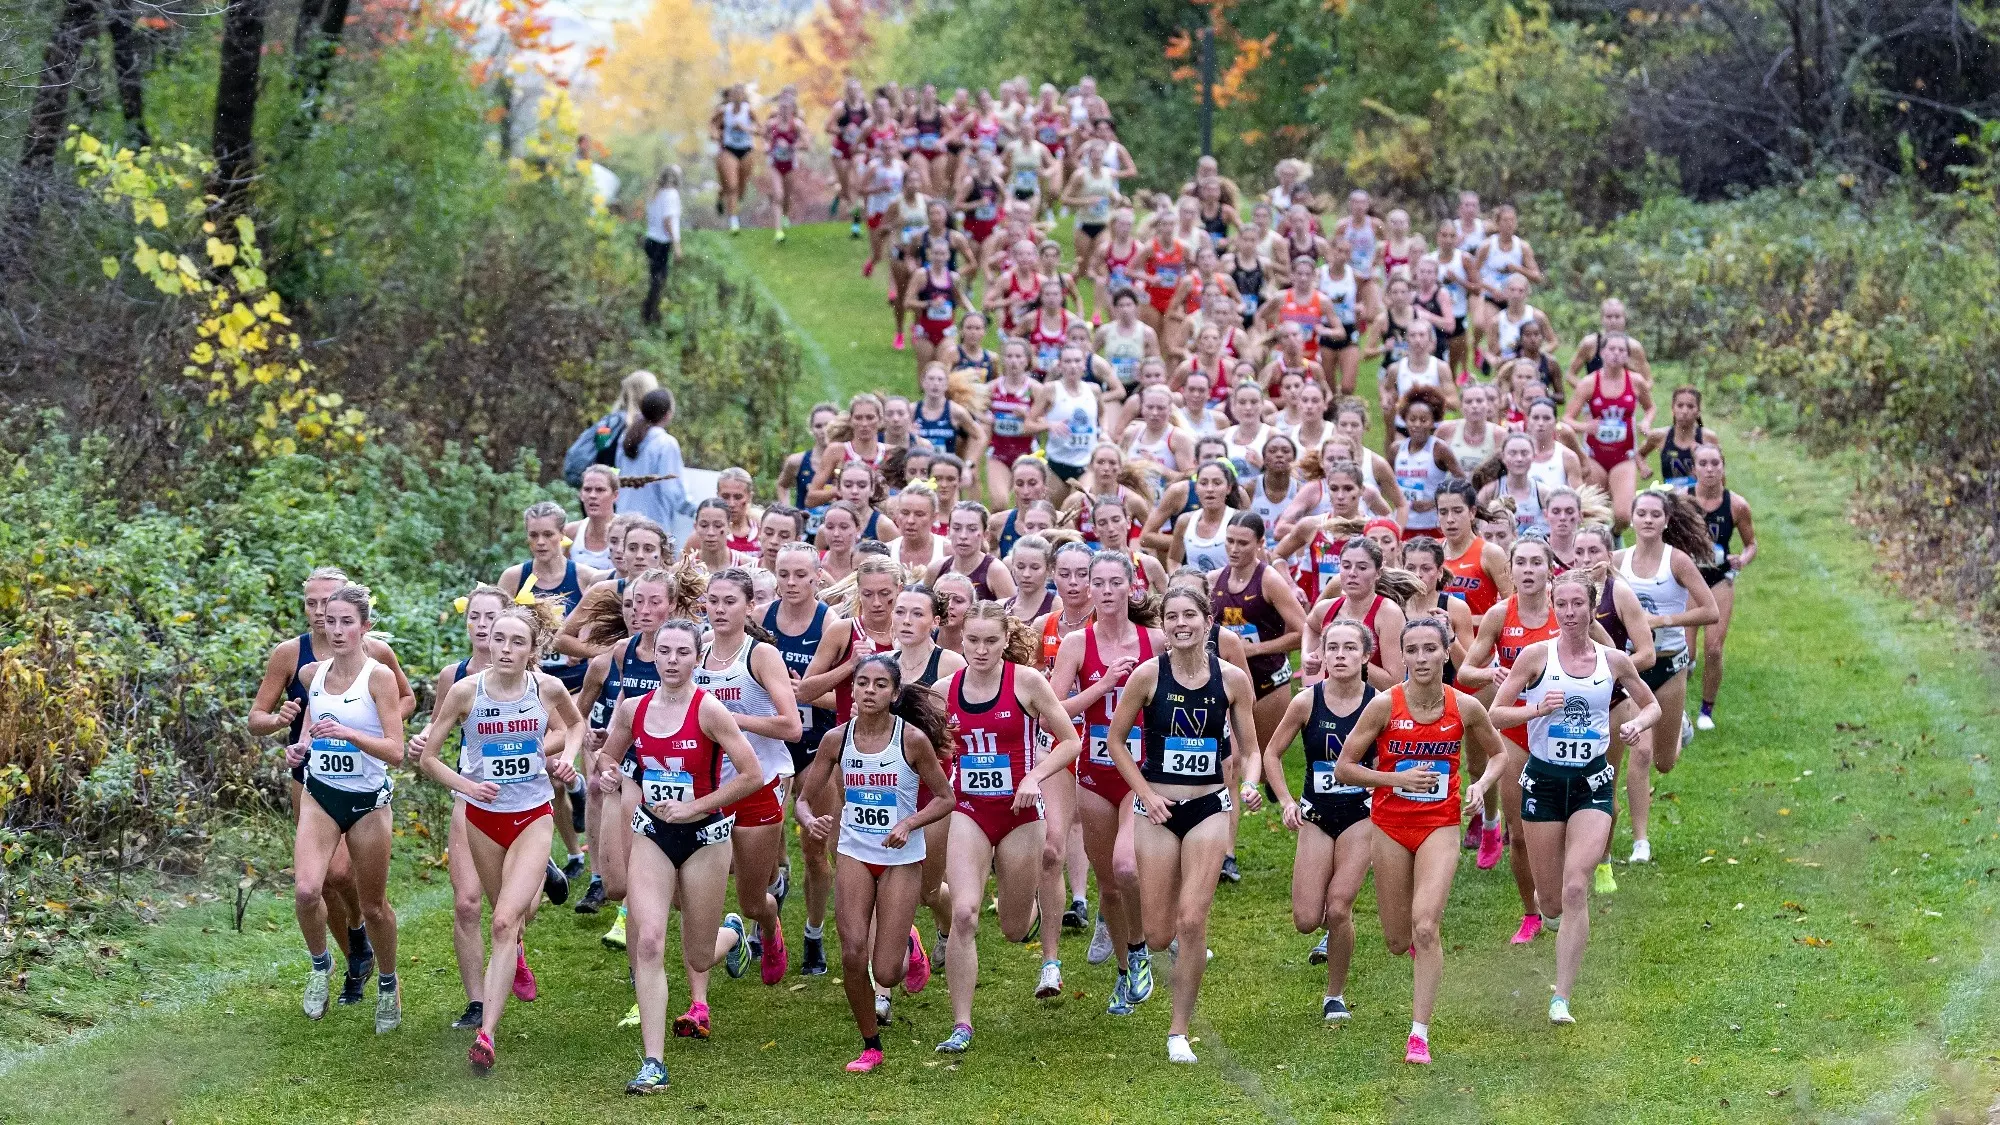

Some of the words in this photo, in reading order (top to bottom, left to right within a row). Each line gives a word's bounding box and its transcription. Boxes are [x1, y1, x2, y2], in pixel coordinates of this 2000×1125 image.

[785, 651, 814, 663] STAT
[622, 677, 638, 688] ENN
[640, 679, 661, 689] STA
[714, 687, 741, 701] STATE
[477, 721, 504, 735] OHIO
[507, 718, 539, 733] STATE
[1388, 739, 1461, 756] ILLINOIS
[1556, 741, 1592, 760] 313
[319, 753, 354, 773] 309
[492, 757, 531, 777] 359
[1172, 753, 1210, 773] 349
[845, 773, 866, 786] OHIO
[868, 773, 898, 787] STATE
[967, 771, 1004, 789] 258
[650, 784, 685, 802] 337
[854, 806, 890, 827] 366
